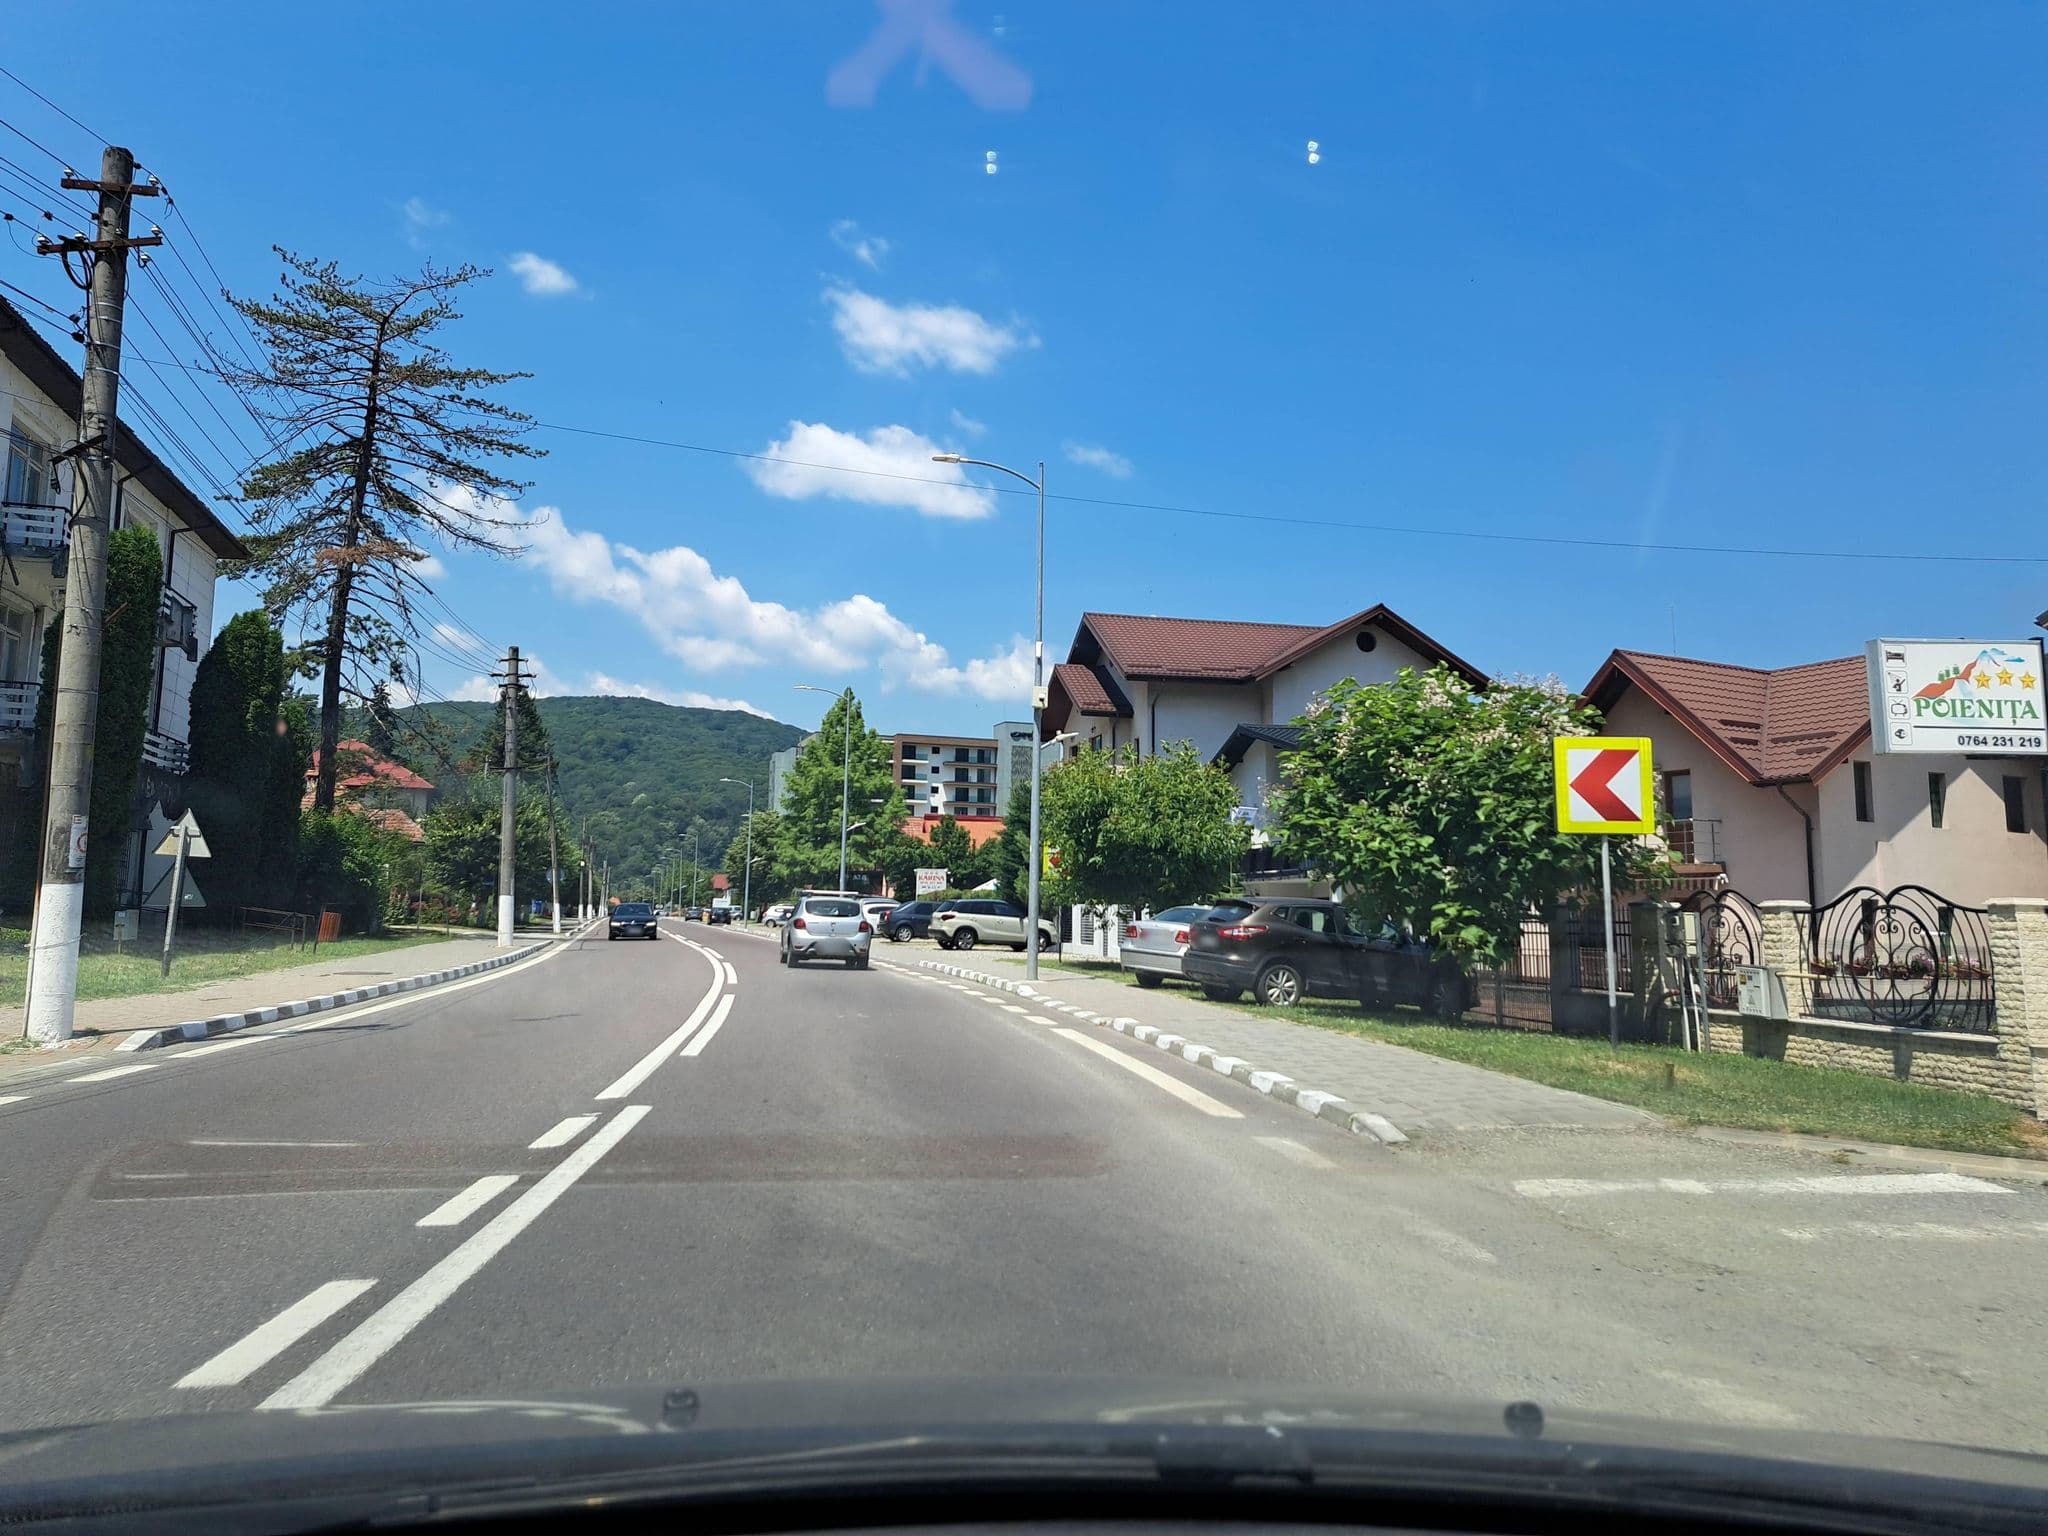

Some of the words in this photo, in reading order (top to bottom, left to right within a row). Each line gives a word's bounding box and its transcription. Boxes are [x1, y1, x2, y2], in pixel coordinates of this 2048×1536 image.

[1957, 735, 1988, 746] 0764
[1992, 736, 2014, 747] 231
[2018, 736, 2041, 748] 219
